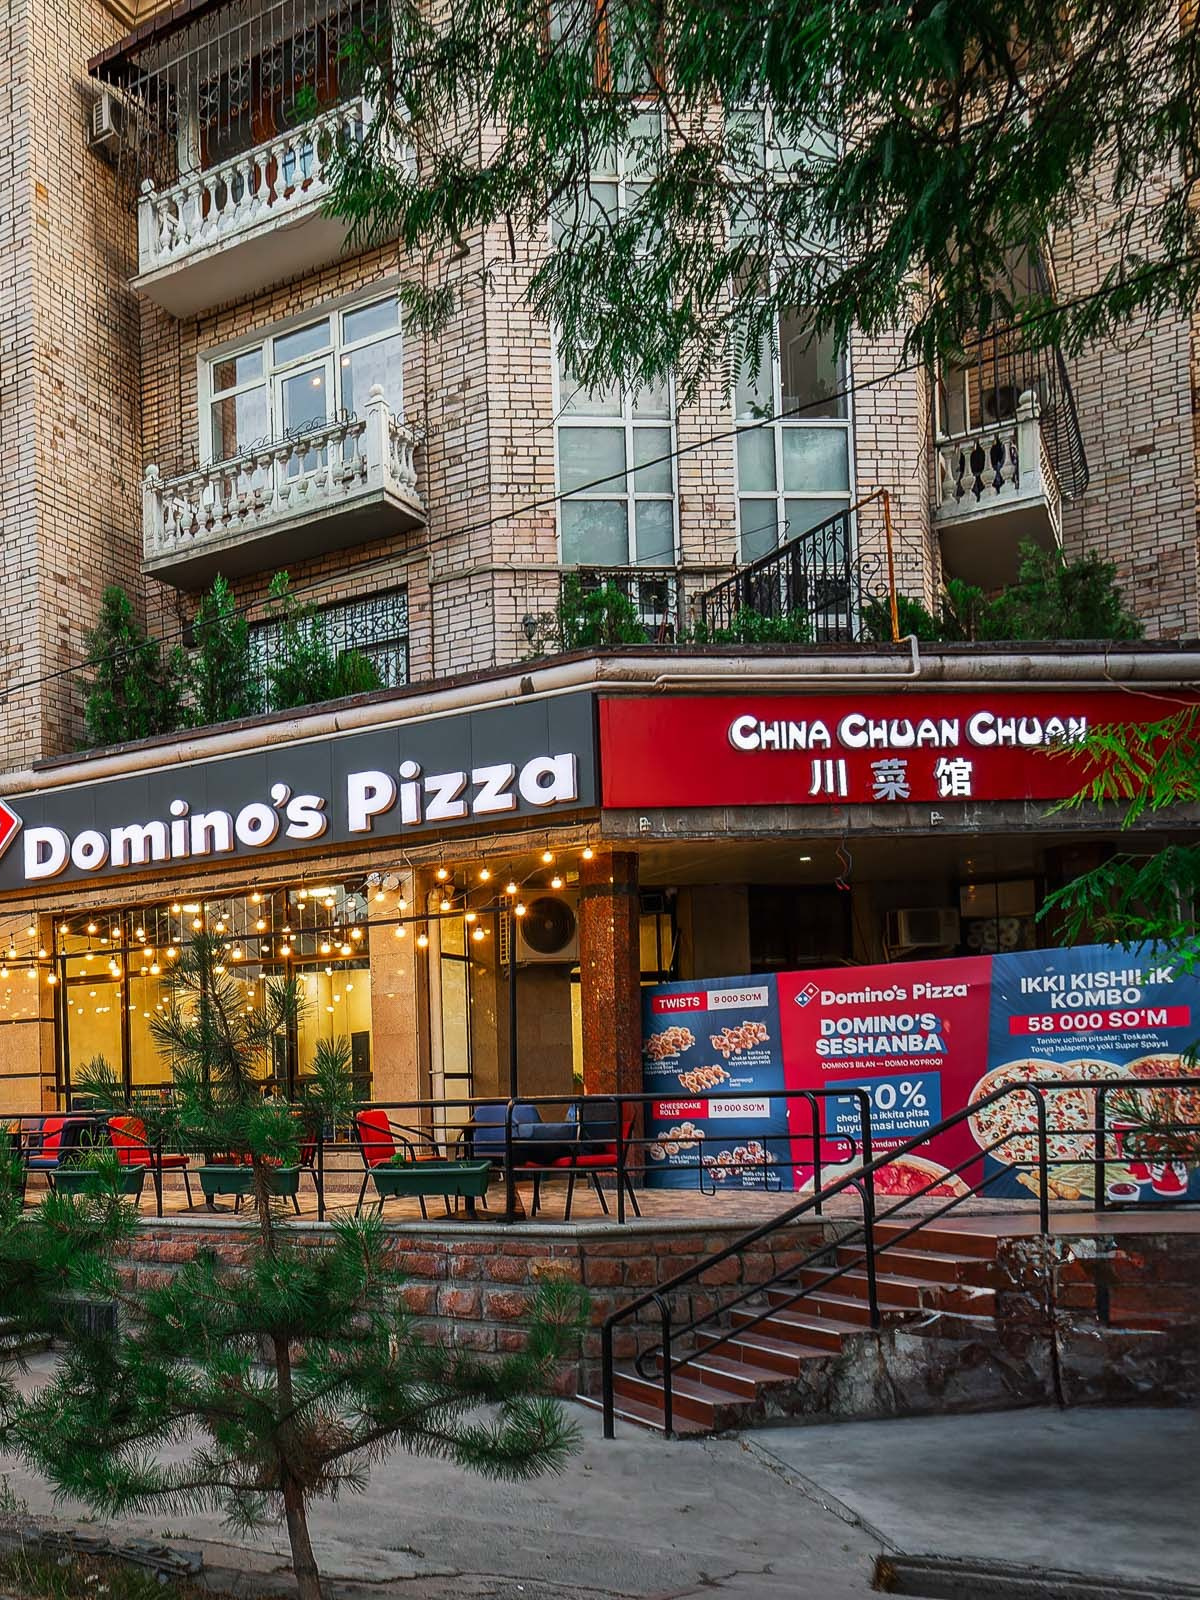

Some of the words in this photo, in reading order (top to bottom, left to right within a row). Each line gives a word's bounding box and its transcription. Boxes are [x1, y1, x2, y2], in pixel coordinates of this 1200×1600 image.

[731, 715, 831, 750] CHINA
[840, 713, 959, 749] CHUAN
[809, 758, 972, 800] 川菜馆
[23, 782, 327, 880] Domino's
[347, 753, 577, 832] Pizza
[820, 985, 908, 1006] Domino's
[912, 982, 968, 1000] Pizza
[1021, 974, 1065, 994] IKKI
[659, 997, 700, 1009] TWISTS
[721, 995, 738, 1004] 000
[1050, 987, 1141, 1009] KOMBO
[820, 1012, 937, 1036] DOMINO'S
[1028, 1016, 1054, 1032] 58
[1059, 1013, 1103, 1030] 000
[815, 1033, 942, 1056] SESHANBA
[713, 1104, 722, 1112] 19
[724, 1104, 742, 1112] 000
[896, 1119, 930, 1130] uchun
